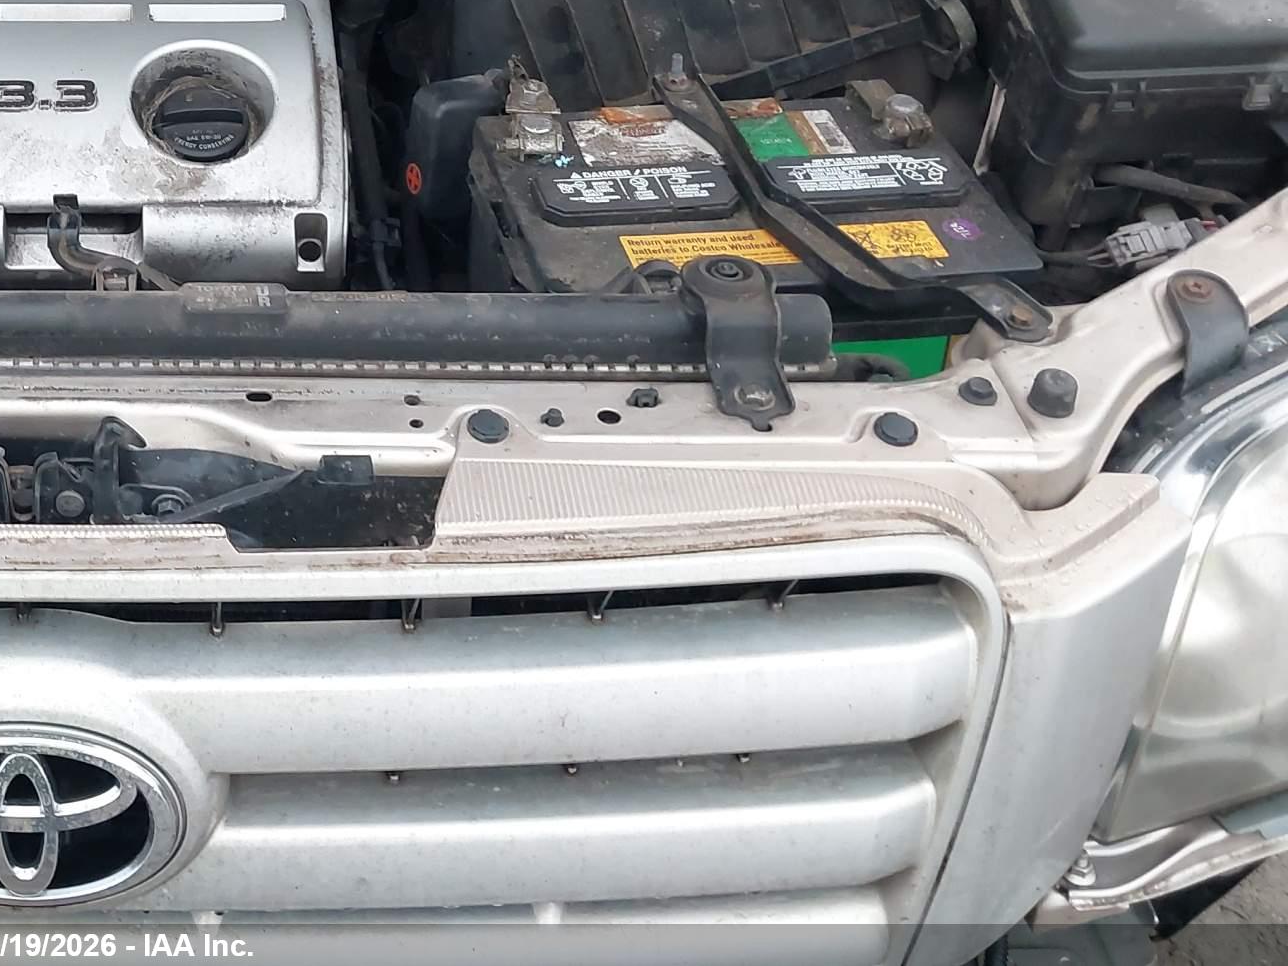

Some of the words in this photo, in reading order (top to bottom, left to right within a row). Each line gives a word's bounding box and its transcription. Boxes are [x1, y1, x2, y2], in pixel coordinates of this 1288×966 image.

[174, 137, 197, 149] ENERGY
[198, 133, 235, 150] CONSERVING
[582, 169, 632, 179] DANGER
[643, 166, 687, 175] POISON
[627, 238, 662, 247] Return
[663, 236, 706, 246] warranty
[710, 234, 728, 243] and
[631, 246, 677, 256] batteries
[679, 245, 690, 254] to
[692, 243, 728, 253] Costco
[729, 240, 783, 251] Wholesale
